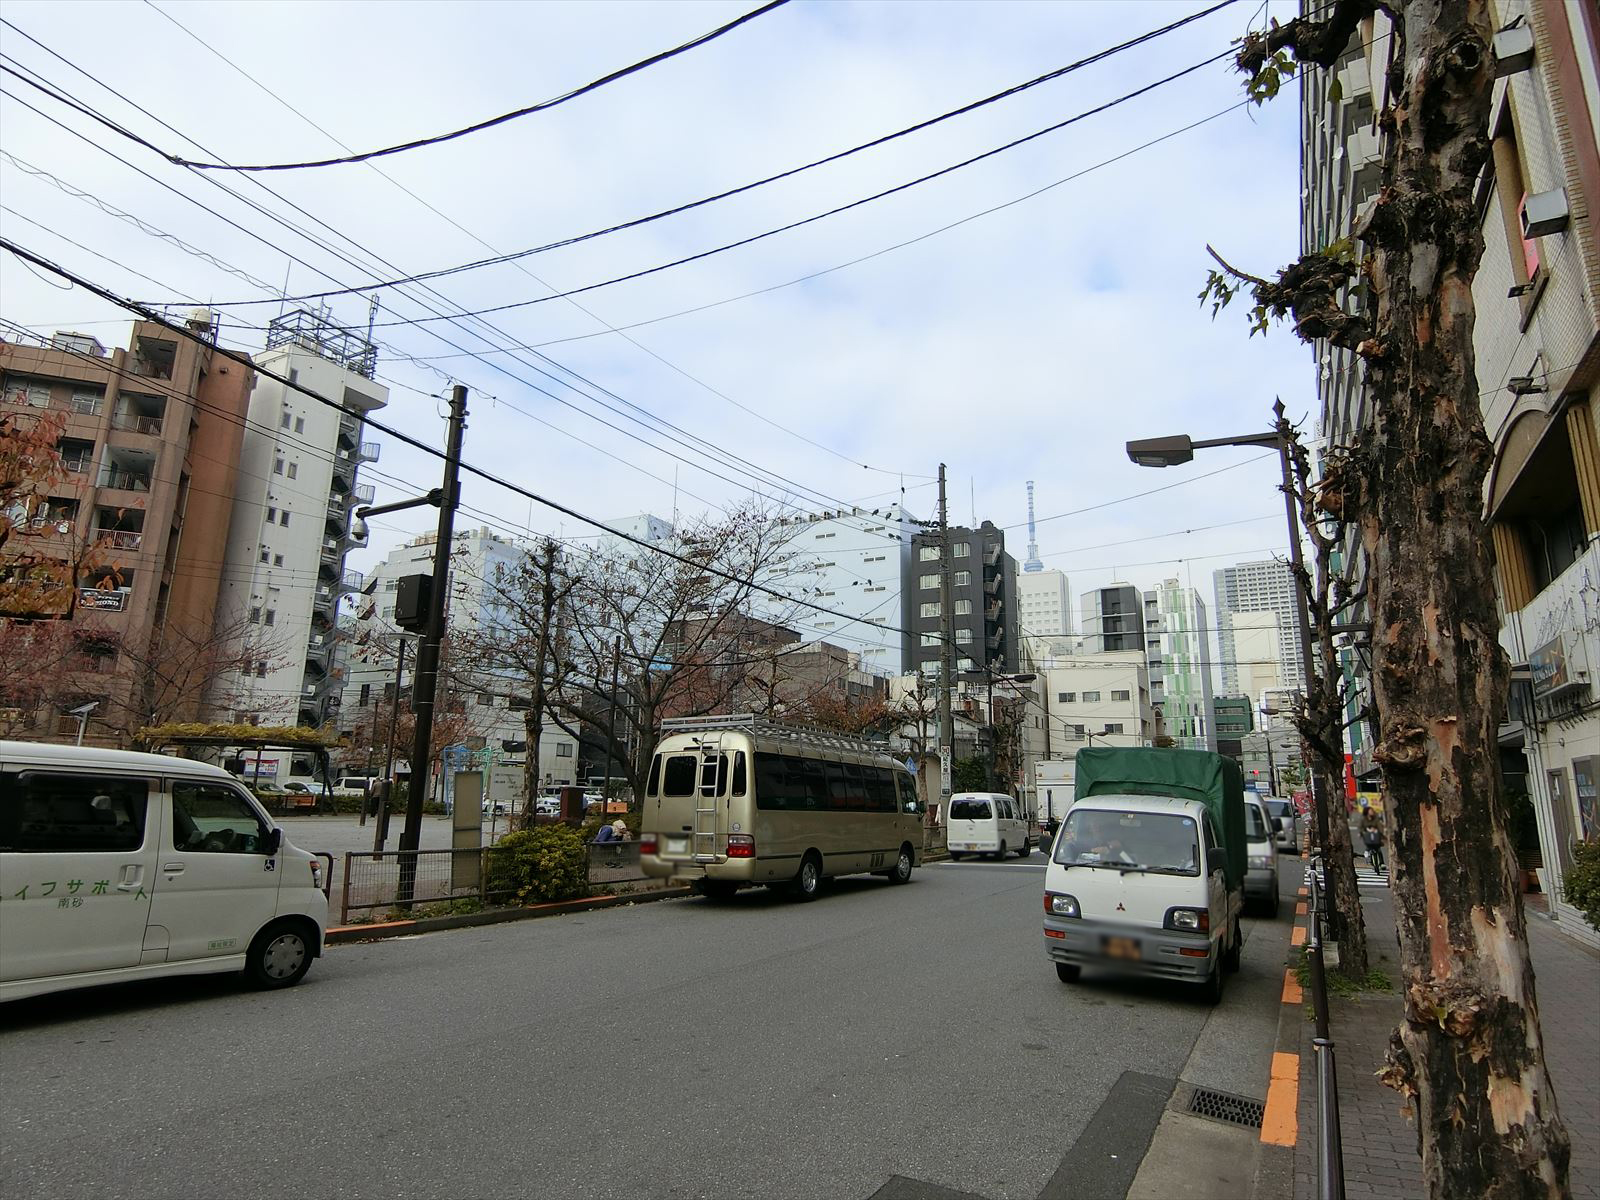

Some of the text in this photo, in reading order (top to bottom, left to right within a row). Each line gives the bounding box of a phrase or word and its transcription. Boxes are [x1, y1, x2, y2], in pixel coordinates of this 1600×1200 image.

[0, 880, 148, 901] イフサポート
[58, 897, 83, 909] 南砂
